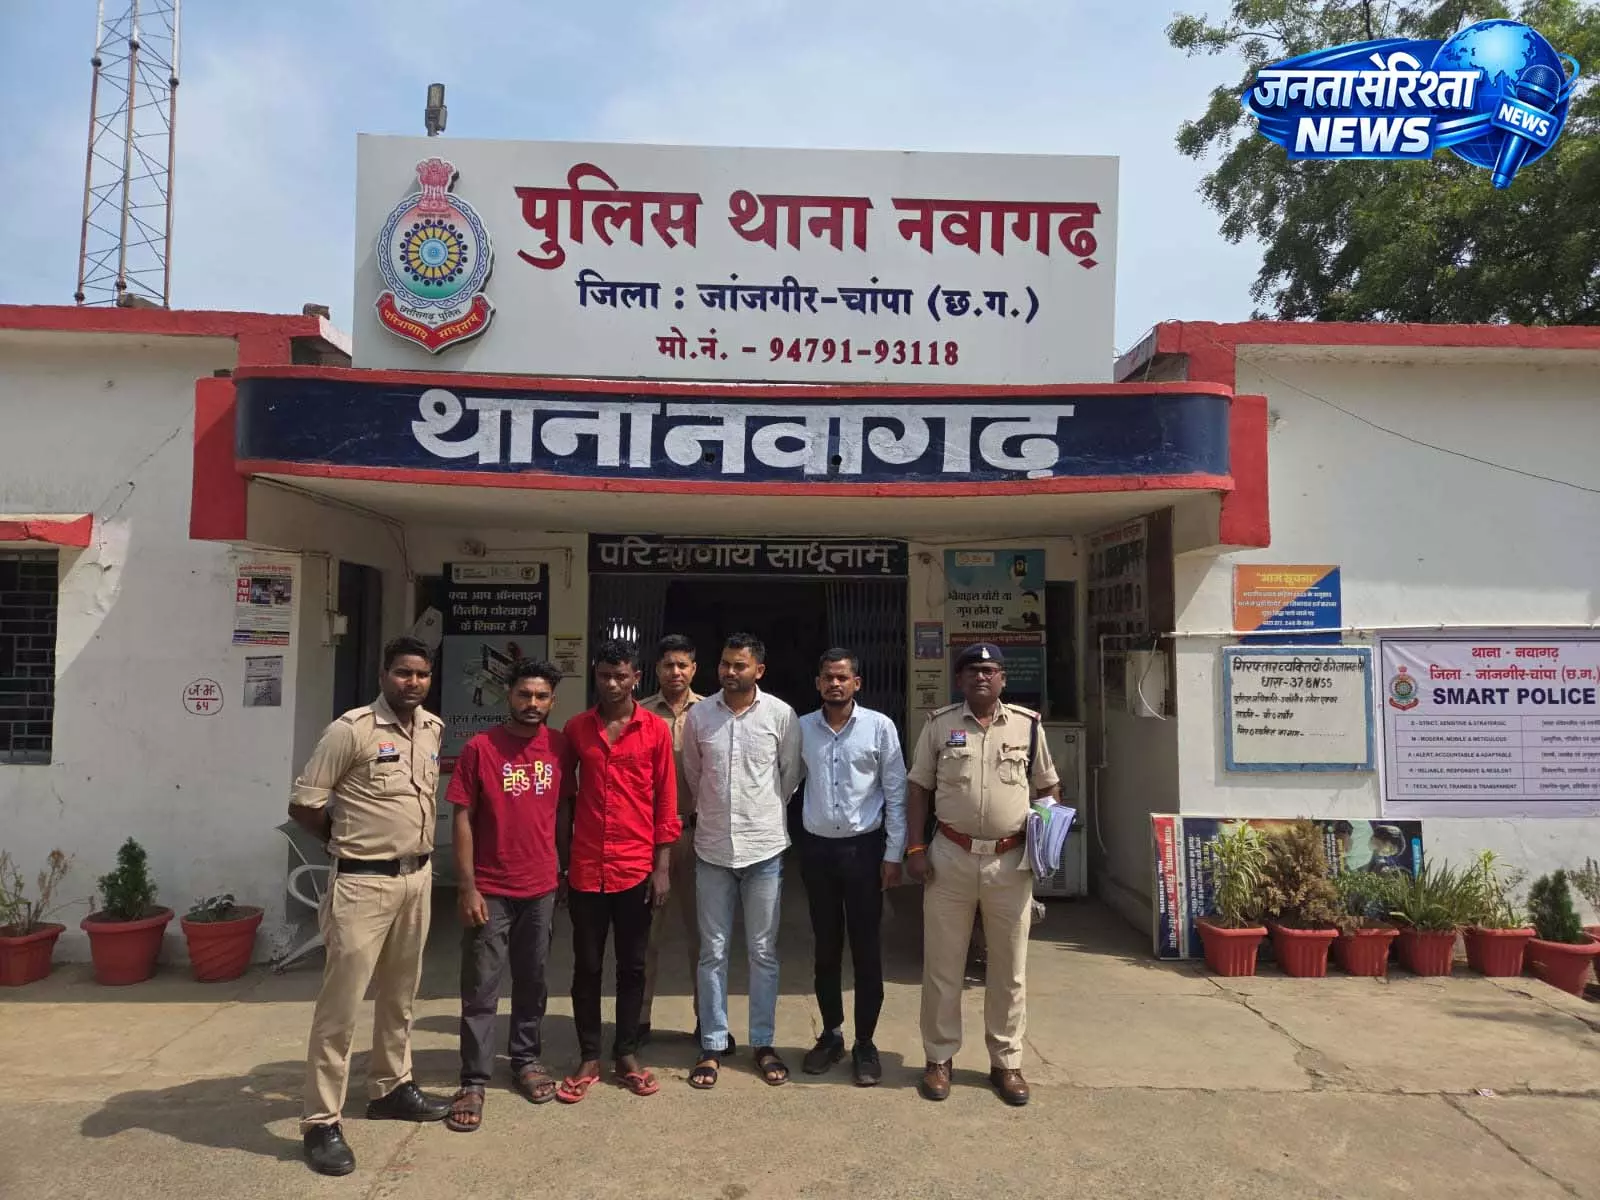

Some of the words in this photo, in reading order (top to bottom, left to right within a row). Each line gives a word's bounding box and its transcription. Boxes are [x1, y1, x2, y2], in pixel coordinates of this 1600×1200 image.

[513, 162, 703, 270] पुलिस
[727, 189, 873, 252] थाना
[892, 196, 1102, 270] नवागढ़
[575, 270, 661, 310] जिला
[927, 285, 1040, 324] (छ.ग.)
[768, 336, 960, 367] 94791-93118
[411, 388, 662, 468] थाना
[1471, 647, 1501, 659] थाना
[1429, 664, 1462, 681] जिला
[1432, 687, 1510, 705] SMART
[1517, 687, 1596, 705] POLICE
